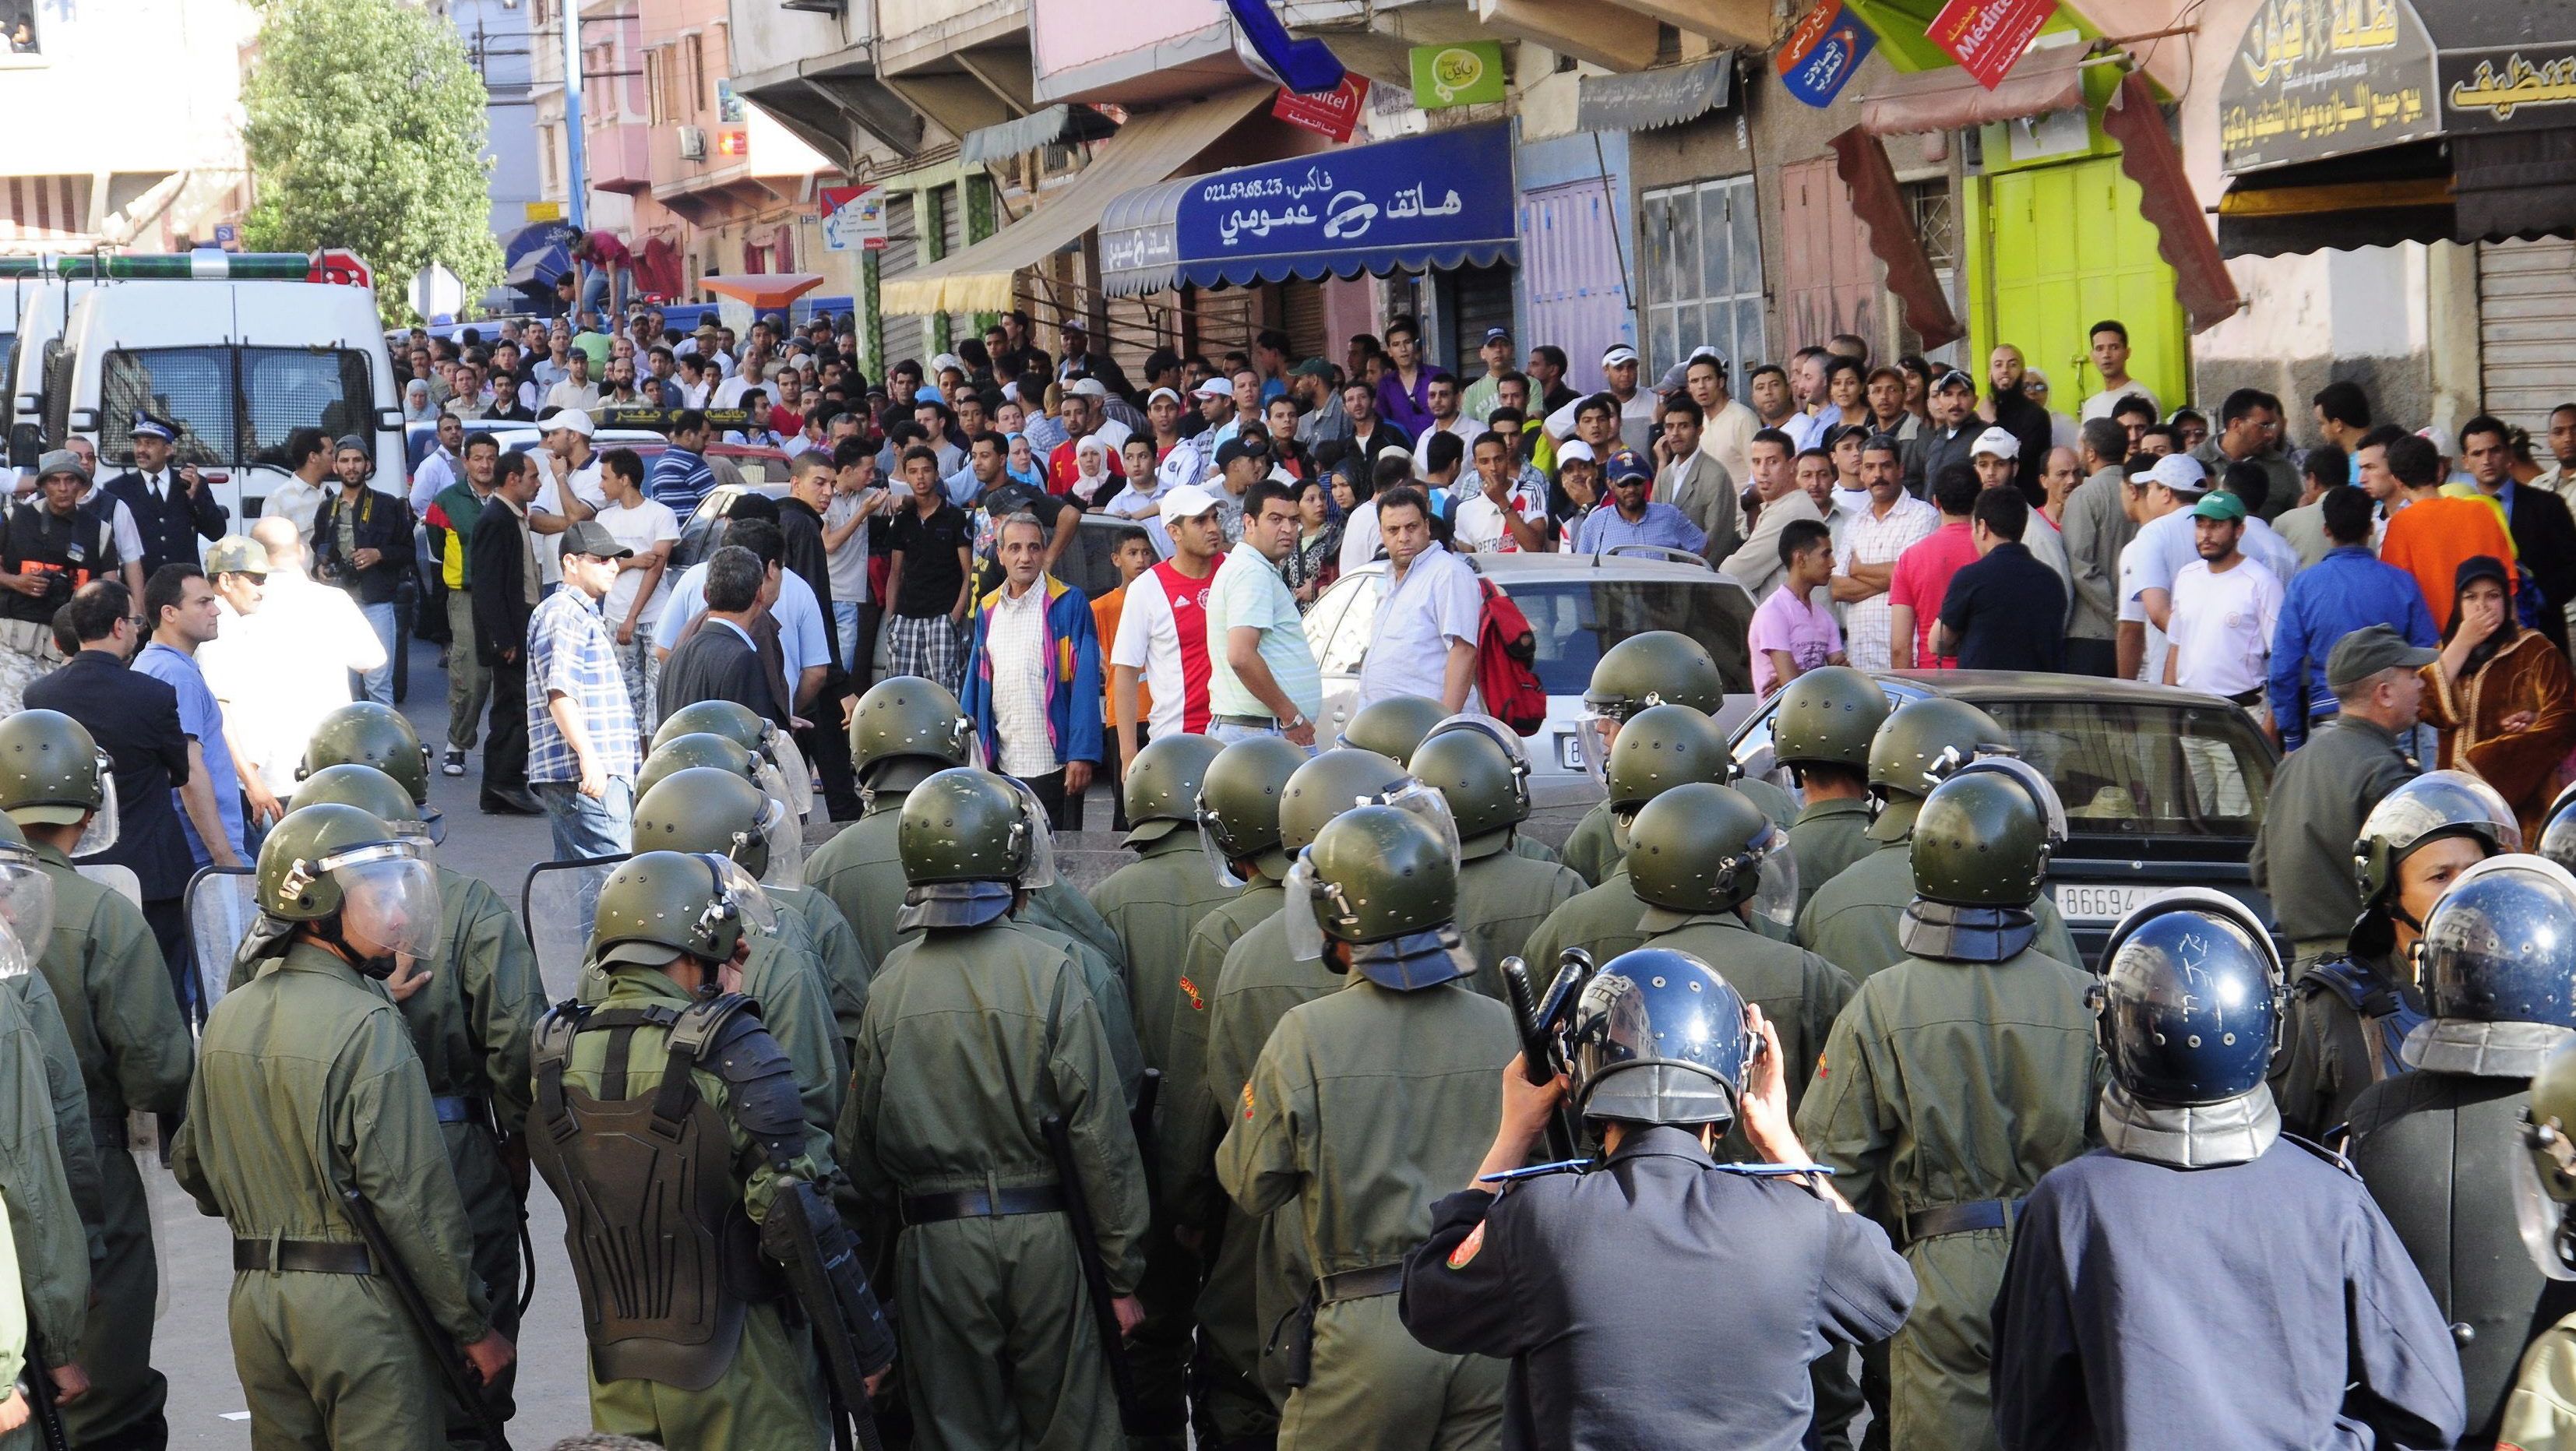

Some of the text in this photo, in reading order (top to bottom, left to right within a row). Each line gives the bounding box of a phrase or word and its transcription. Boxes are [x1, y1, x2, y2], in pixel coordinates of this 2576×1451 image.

[1955, 0, 2014, 61] Médite
[2447, 51, 2576, 122] تنظيف
[1220, 181, 1462, 246] هاتف عمومي
